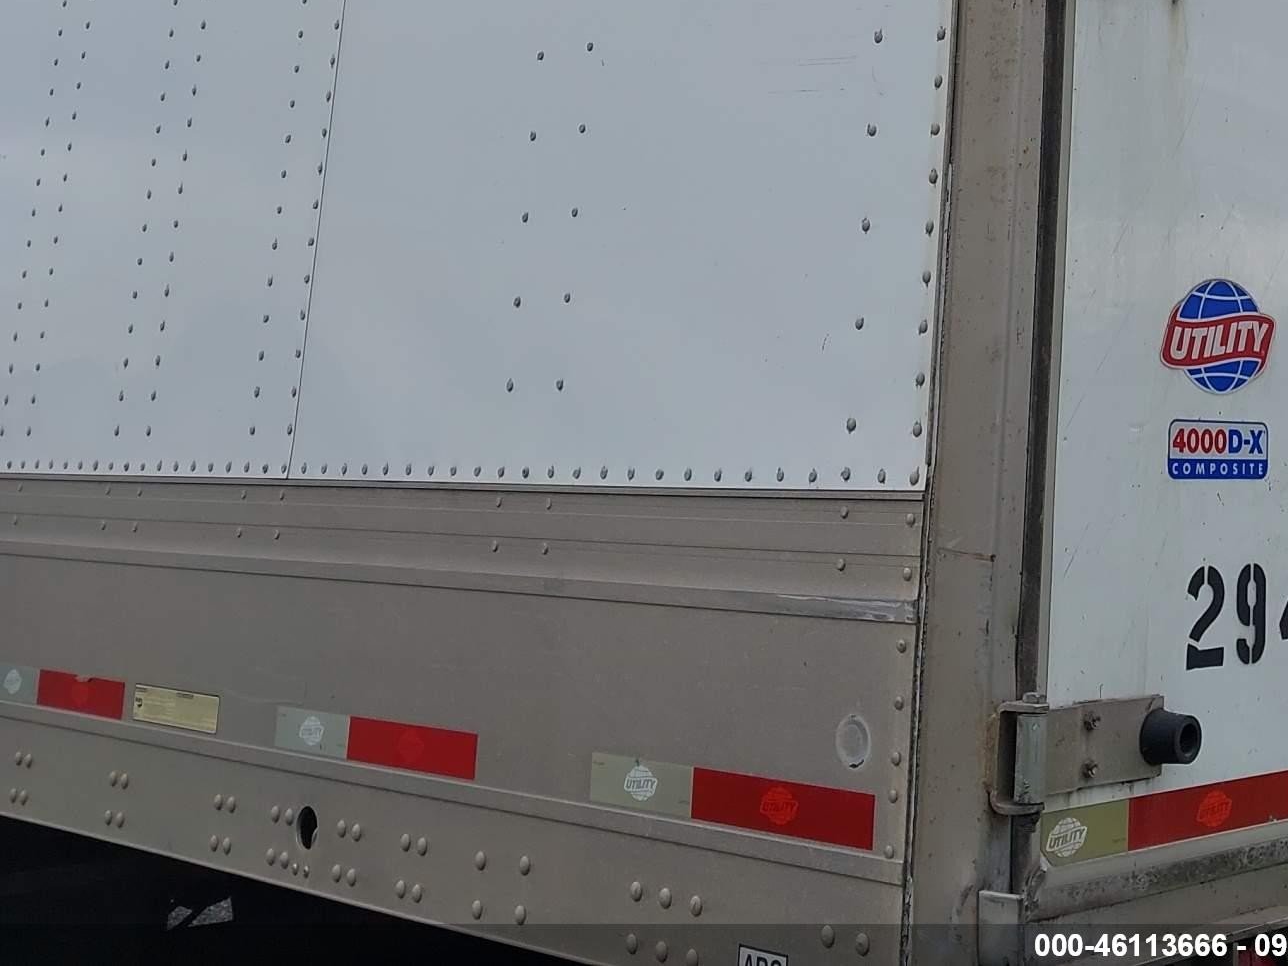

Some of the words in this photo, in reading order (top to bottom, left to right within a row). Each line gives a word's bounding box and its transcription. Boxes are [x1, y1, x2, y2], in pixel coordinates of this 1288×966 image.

[1169, 320, 1270, 360] UTILITY
[1172, 427, 1265, 455] 4000D-X
[1171, 462, 1264, 476] COMPOSITE
[625, 777, 657, 792] UTILITY
[1048, 828, 1086, 850] UTILITY
